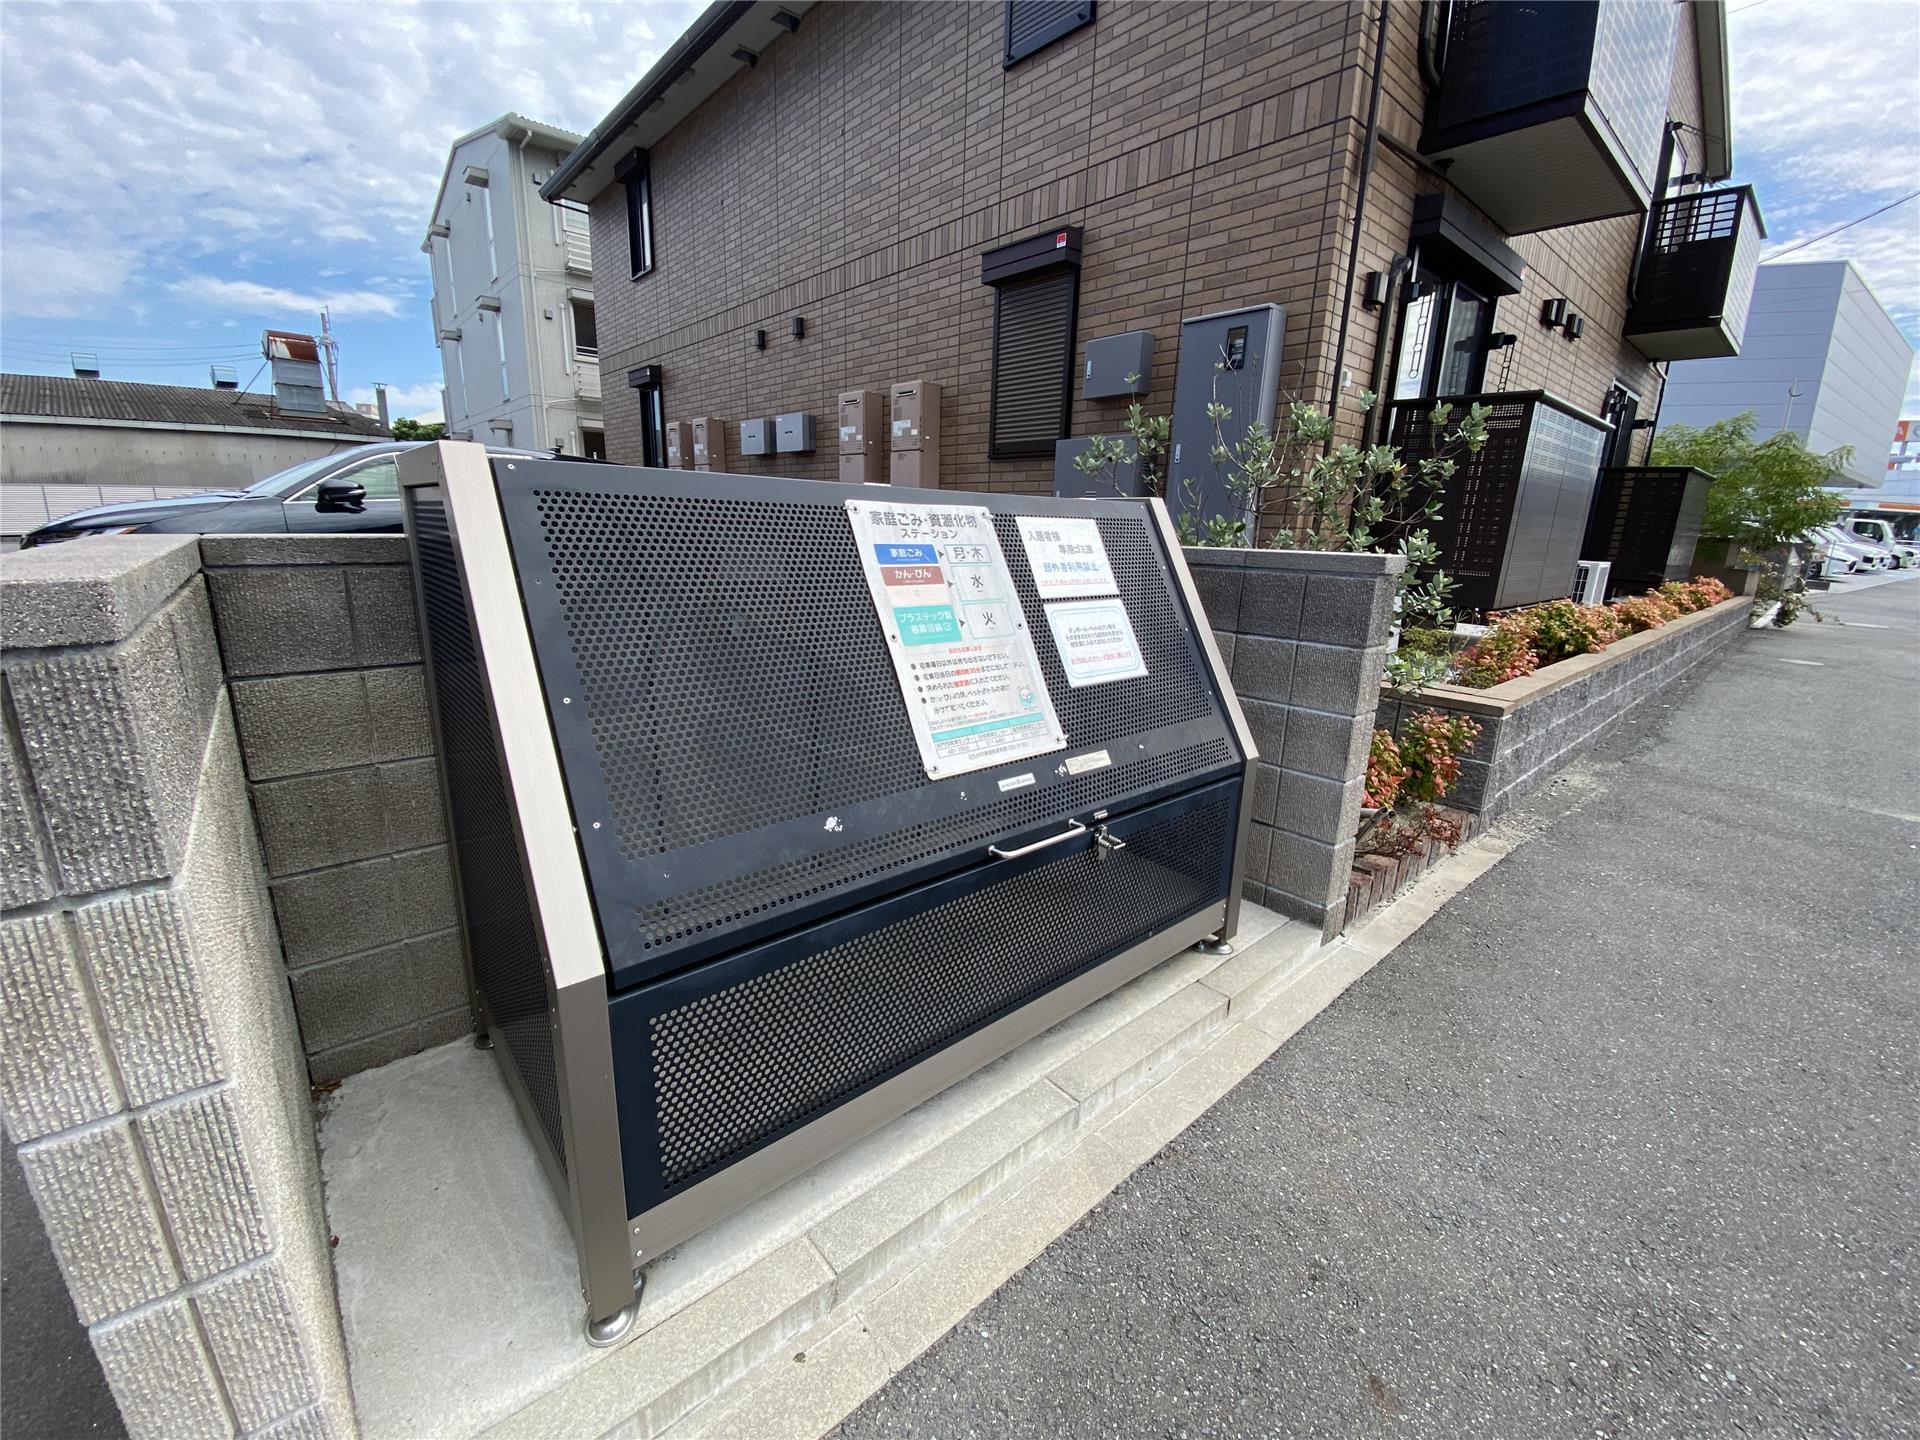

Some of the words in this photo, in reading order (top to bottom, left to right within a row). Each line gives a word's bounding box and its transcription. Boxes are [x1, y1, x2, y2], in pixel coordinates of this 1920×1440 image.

[869, 511, 978, 528] 家庭ごみ・資源化物
[901, 528, 958, 539] ステーション
[1028, 530, 1061, 542] 入居者様
[889, 548, 923, 558] 家庭ごみ
[954, 546, 984, 560] 月・木
[895, 569, 932, 579] かん・びん
[971, 574, 984, 588] 水
[982, 611, 996, 626] 火
